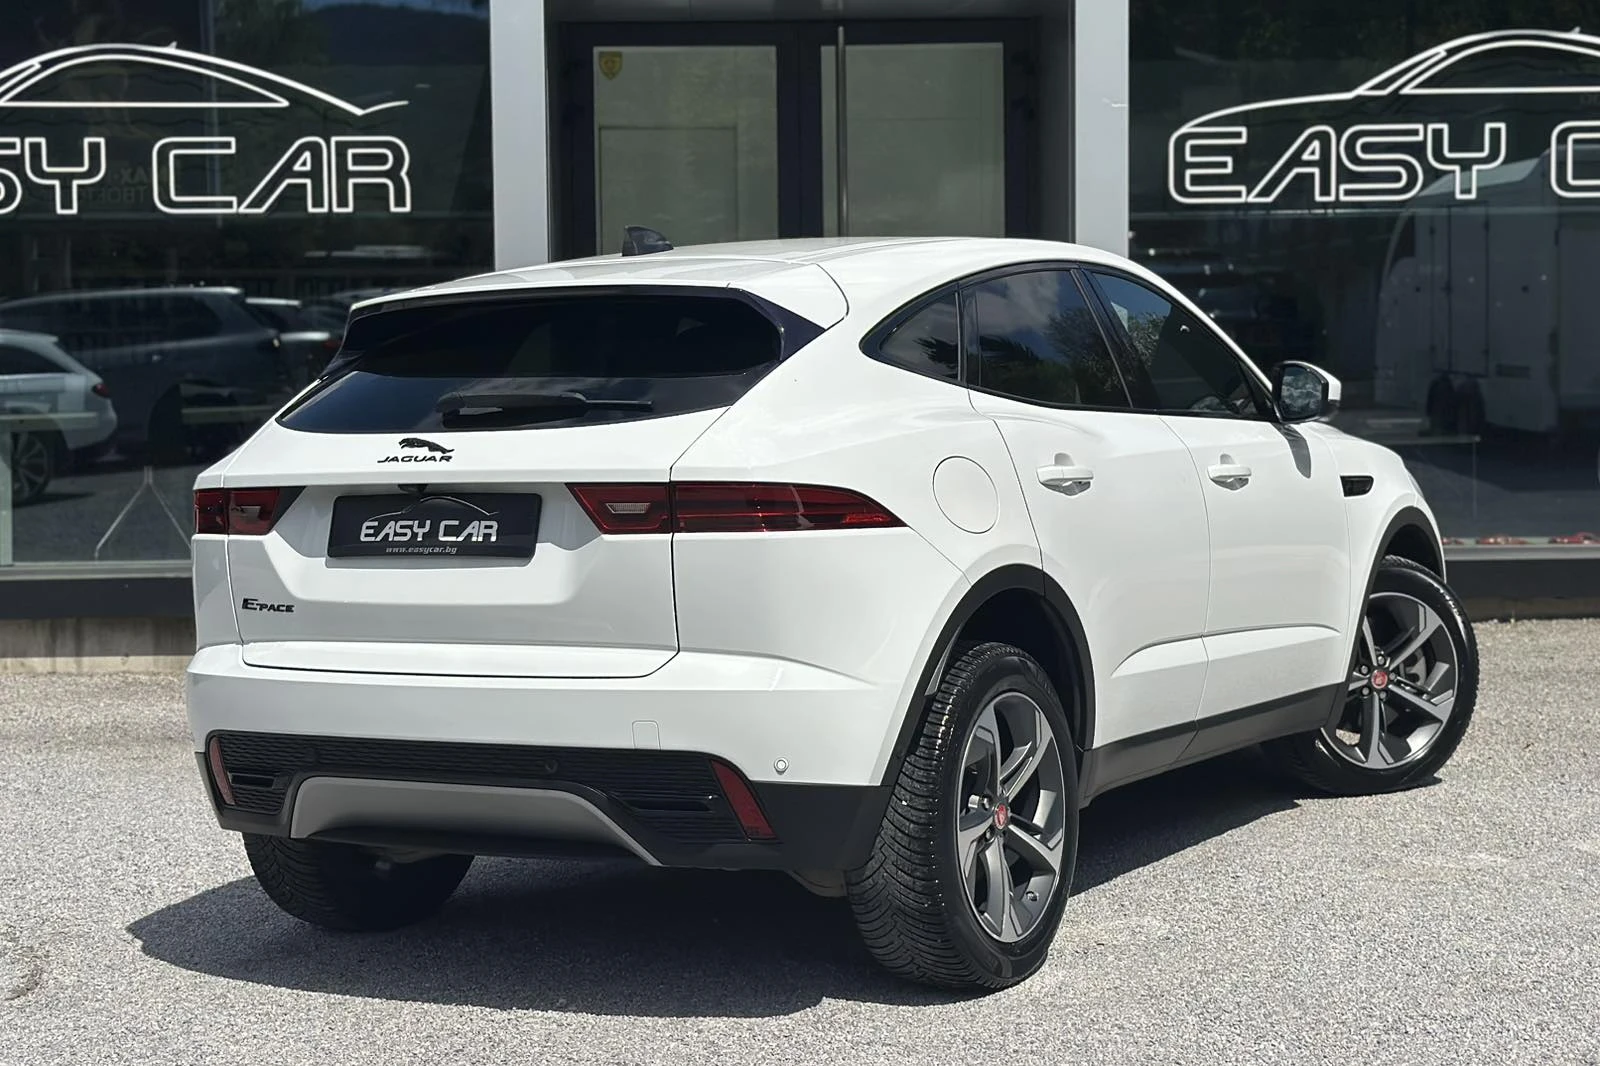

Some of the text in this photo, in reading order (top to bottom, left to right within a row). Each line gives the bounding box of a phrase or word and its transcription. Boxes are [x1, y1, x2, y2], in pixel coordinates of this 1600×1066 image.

[1168, 122, 1507, 204] EASY
[152, 136, 411, 214] CAR
[377, 455, 453, 463] JAGUAR
[360, 520, 498, 542] EASY CAR
[386, 546, 458, 555] www.easycar.bg
